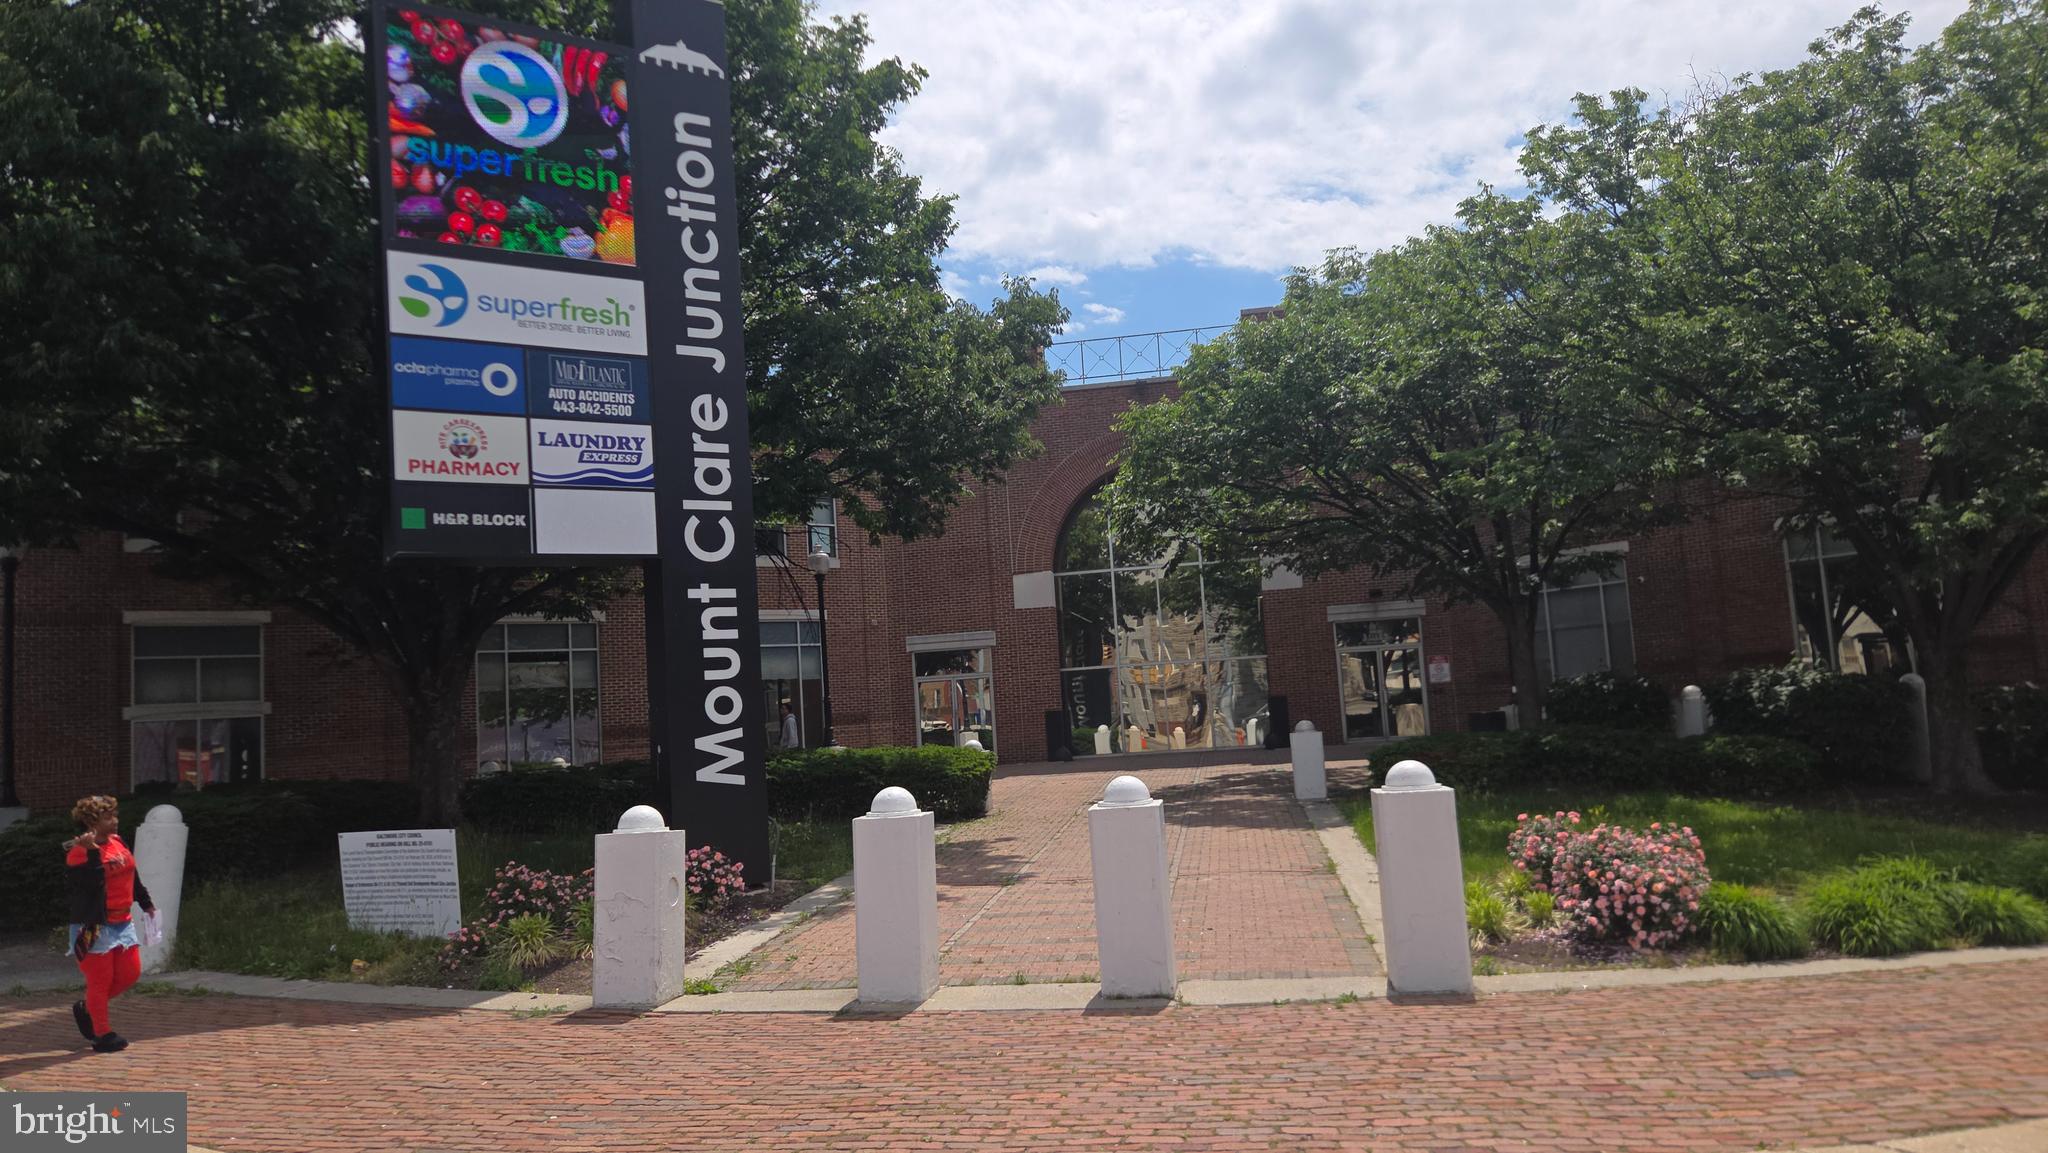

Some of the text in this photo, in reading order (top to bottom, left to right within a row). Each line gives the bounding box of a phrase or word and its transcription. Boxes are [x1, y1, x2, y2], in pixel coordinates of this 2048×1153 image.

[405, 136, 619, 193] superfresh
[477, 294, 631, 328] superfresh
[518, 320, 547, 330] BETTER
[577, 325, 605, 336] BETTER
[394, 361, 480, 379] octapharma
[549, 387, 635, 405] AUTO ACCIDENTS
[553, 400, 632, 417] 443-842-5500
[538, 431, 646, 451] LAUNDRY
[665, 111, 746, 785] Mount Clare Junction
[582, 452, 638, 463] EXPRESS
[408, 458, 520, 477] PHARMACY
[432, 512, 527, 527] H&R BLOCK
